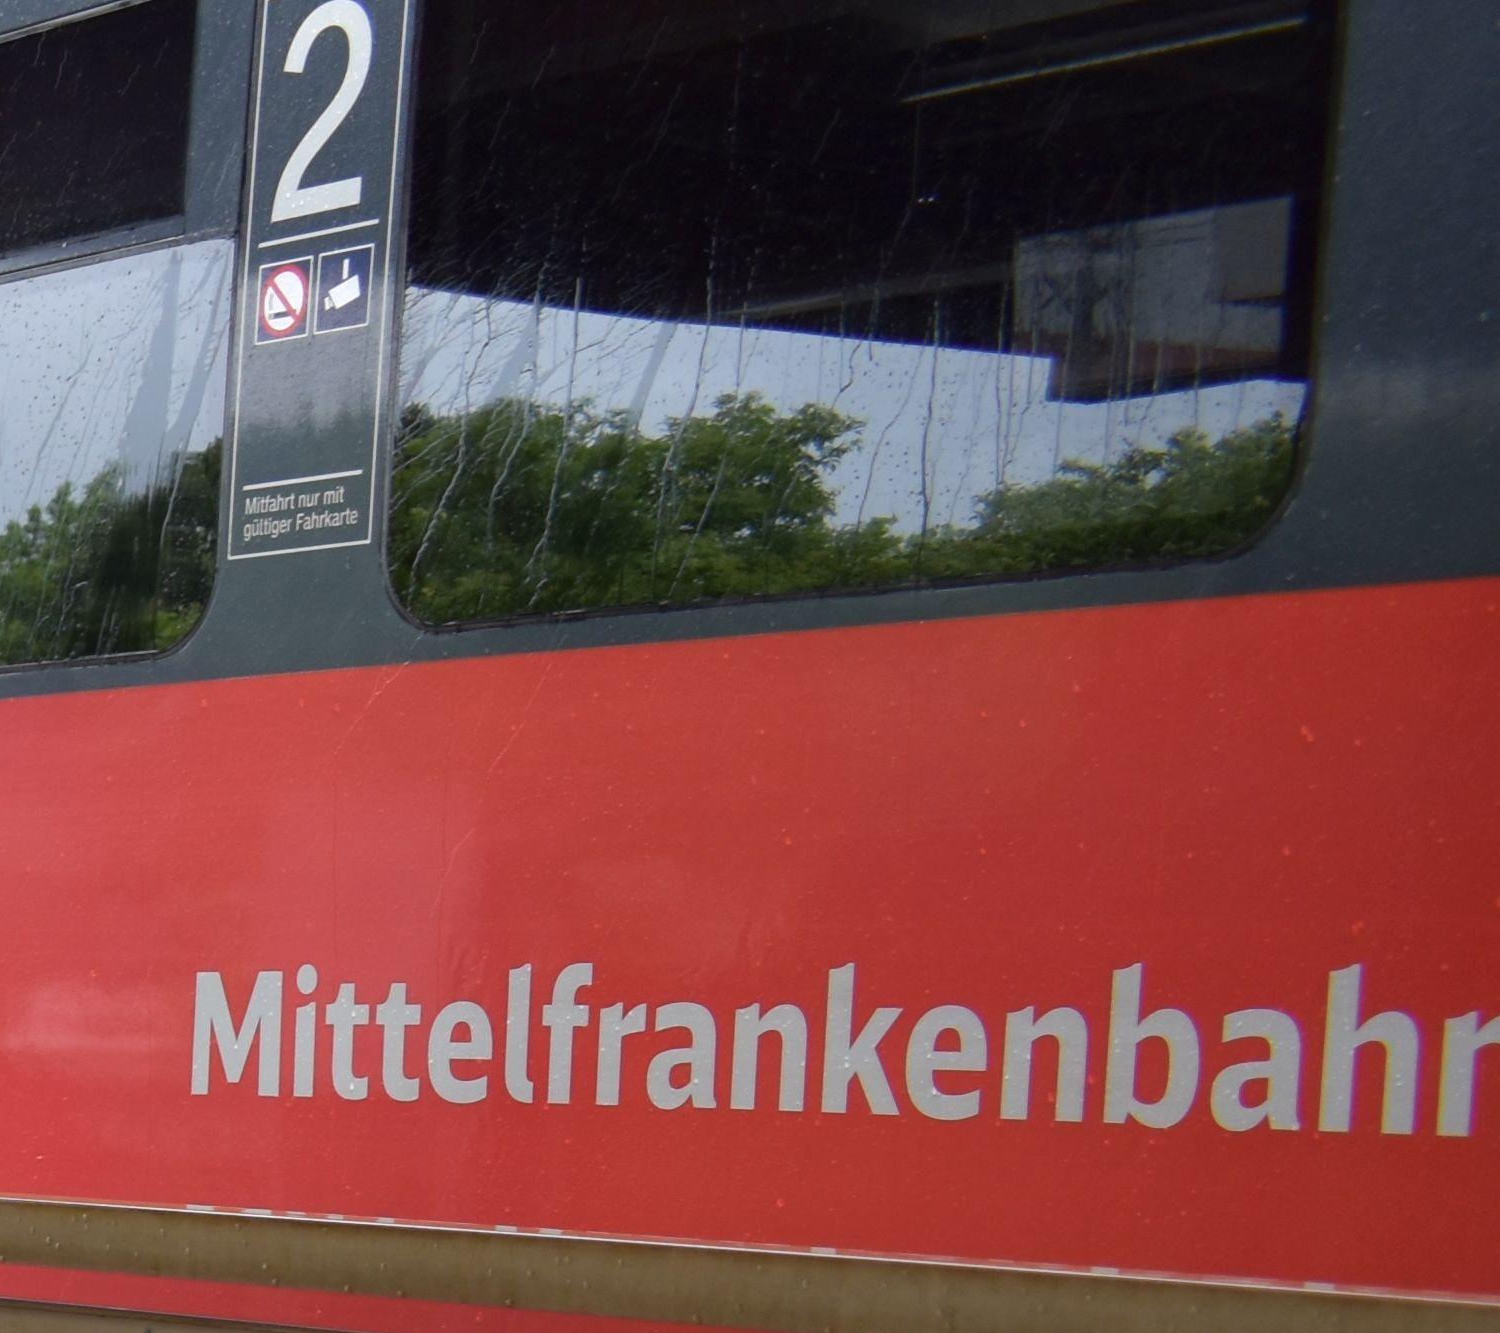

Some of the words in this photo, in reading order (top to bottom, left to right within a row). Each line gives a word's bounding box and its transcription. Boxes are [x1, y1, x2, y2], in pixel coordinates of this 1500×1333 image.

[270, 0, 375, 224] 2
[244, 492, 296, 515] Mitfahrt
[297, 492, 321, 509] nur
[322, 485, 345, 505] mit
[243, 517, 294, 542] gültiger
[295, 508, 359, 531] Fahrkarte
